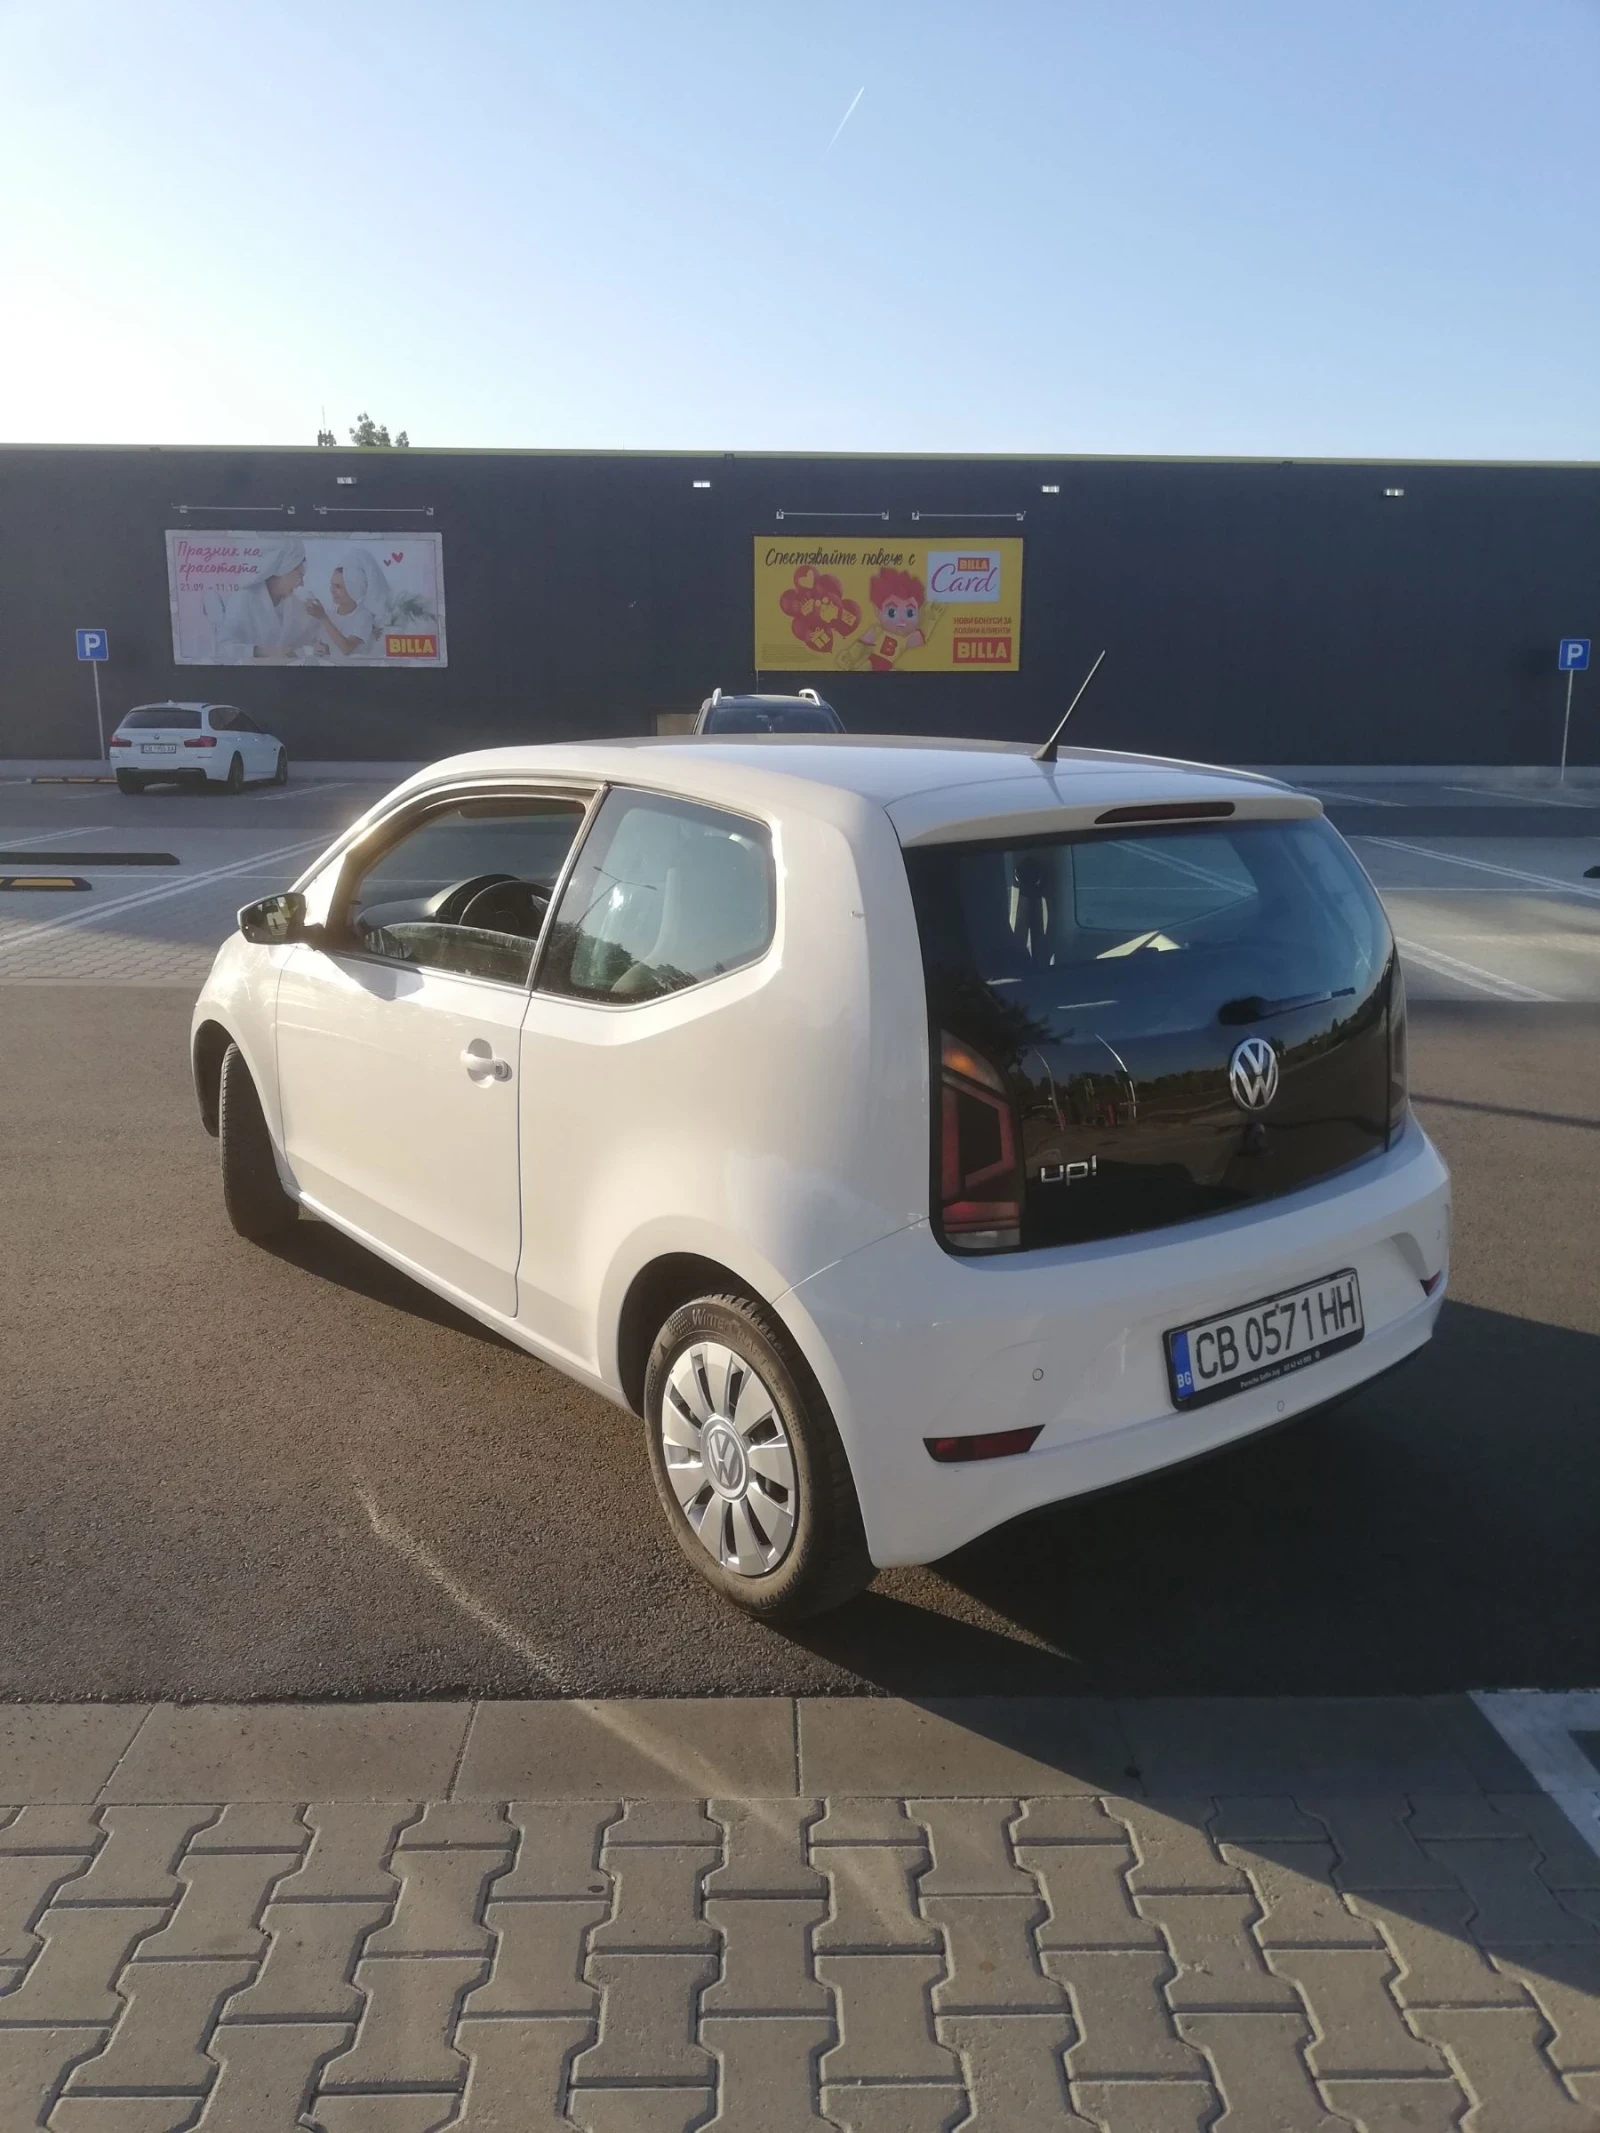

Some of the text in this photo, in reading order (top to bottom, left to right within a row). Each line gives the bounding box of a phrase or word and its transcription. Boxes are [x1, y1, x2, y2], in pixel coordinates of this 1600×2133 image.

[177, 540, 262, 563] Празник на
[765, 547, 858, 567] Спестявайте
[862, 548, 904, 566] повече
[179, 563, 259, 581] красотата
[959, 559, 989, 570] BILLA
[180, 583, 204, 592] 21.09
[216, 584, 239, 592] 11.10
[931, 563, 998, 593] Card
[84, 633, 101, 657] P
[388, 638, 434, 654] BILLA
[880, 635, 898, 656] B
[957, 642, 1008, 659] BILLA
[1567, 643, 1583, 666] P
[1041, 1154, 1097, 1186] up!
[1196, 1281, 1357, 1380] CB 0571 HH
[1176, 1371, 1192, 1389] BG
